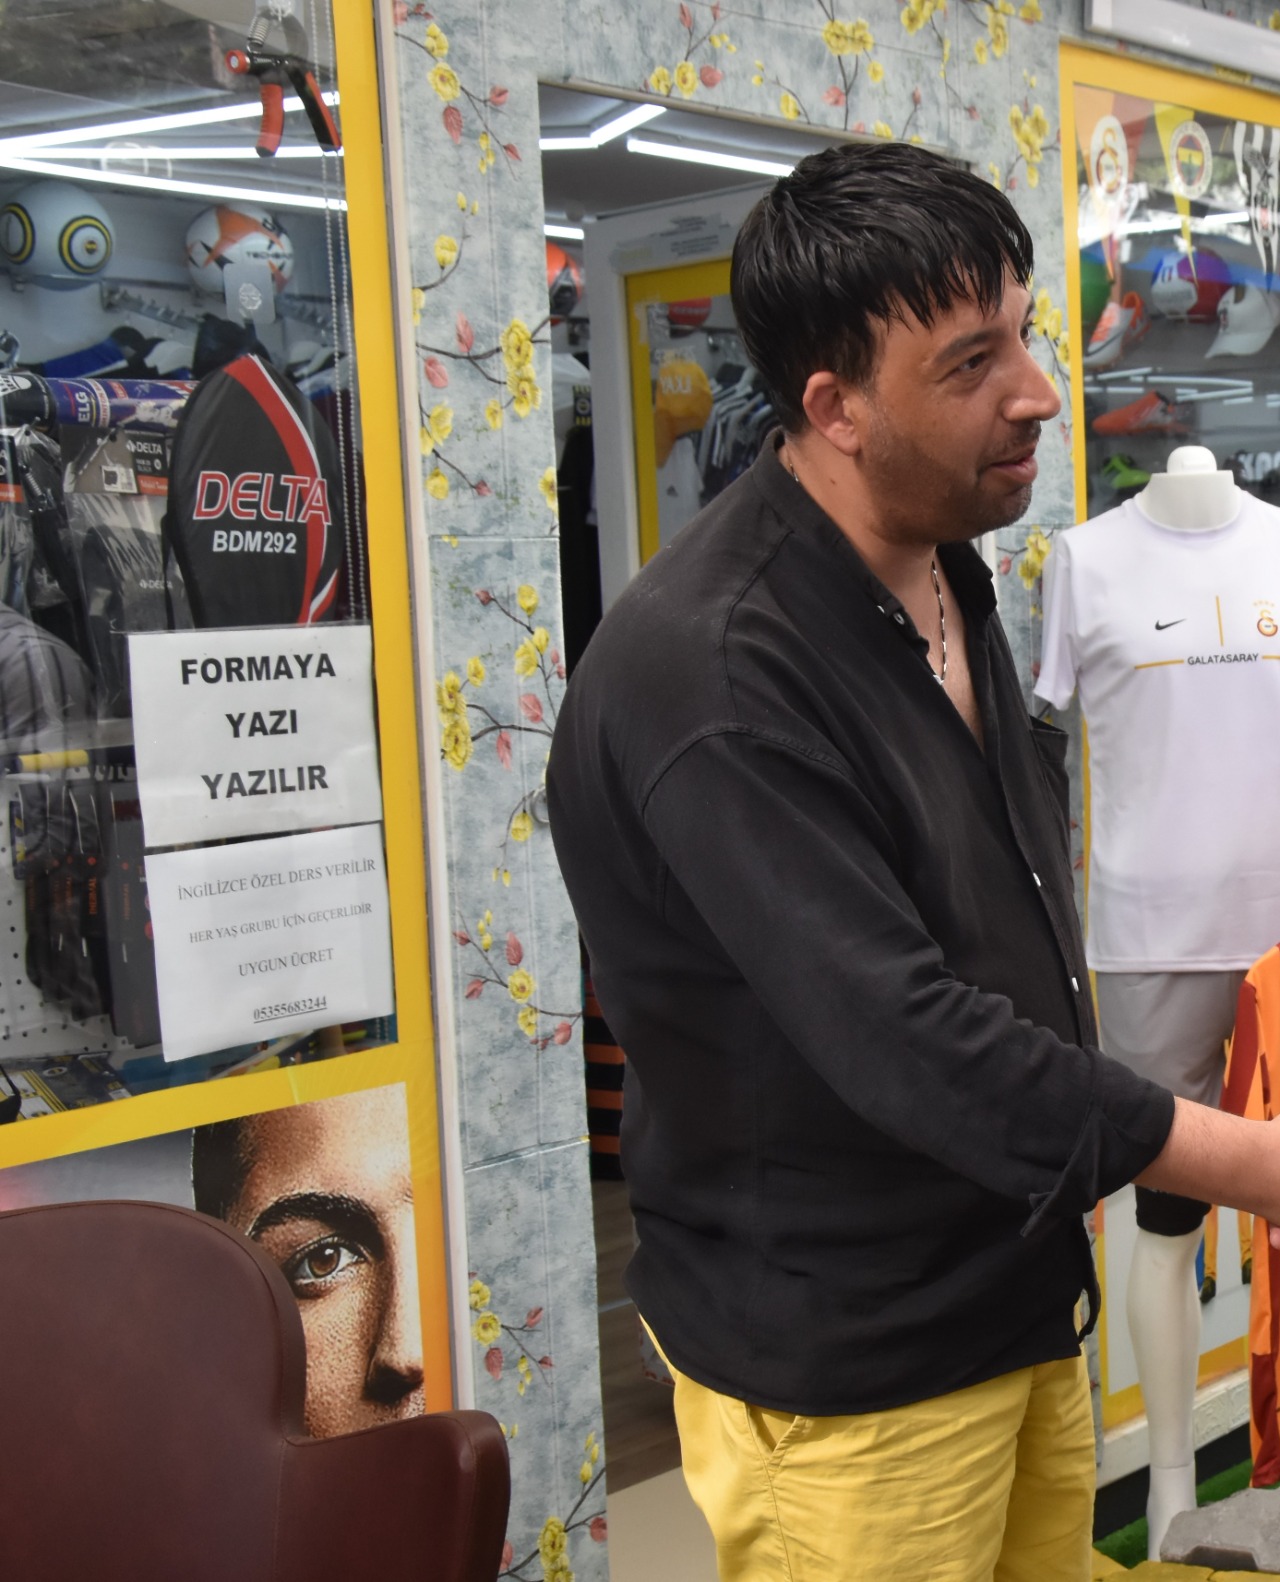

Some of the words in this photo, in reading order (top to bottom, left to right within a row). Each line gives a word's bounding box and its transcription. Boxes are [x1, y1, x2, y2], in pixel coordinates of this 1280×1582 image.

[135, 440, 163, 455] DELTA
[193, 470, 332, 526] DELTA
[212, 530, 297, 554] BDM292
[181, 653, 336, 685] FORMAYA
[1187, 653, 1259, 666] GALATASARAY
[225, 709, 298, 738] YAZI
[201, 765, 329, 800] YAZILIR
[178, 877, 248, 900] İNGİLİZCE
[251, 873, 286, 889] ÖZEL
[288, 867, 322, 884] DERS
[324, 859, 376, 878] VERİLİR
[189, 930, 214, 943] HER
[215, 925, 238, 939] YAŞ
[240, 917, 280, 935] GRUBU
[282, 913, 306, 929] İÇİN
[308, 902, 373, 923] GEÇERLİDİR
[238, 956, 288, 977] UYGUN
[290, 948, 335, 968] ÜCRET
[253, 996, 328, 1023] 05355683244
